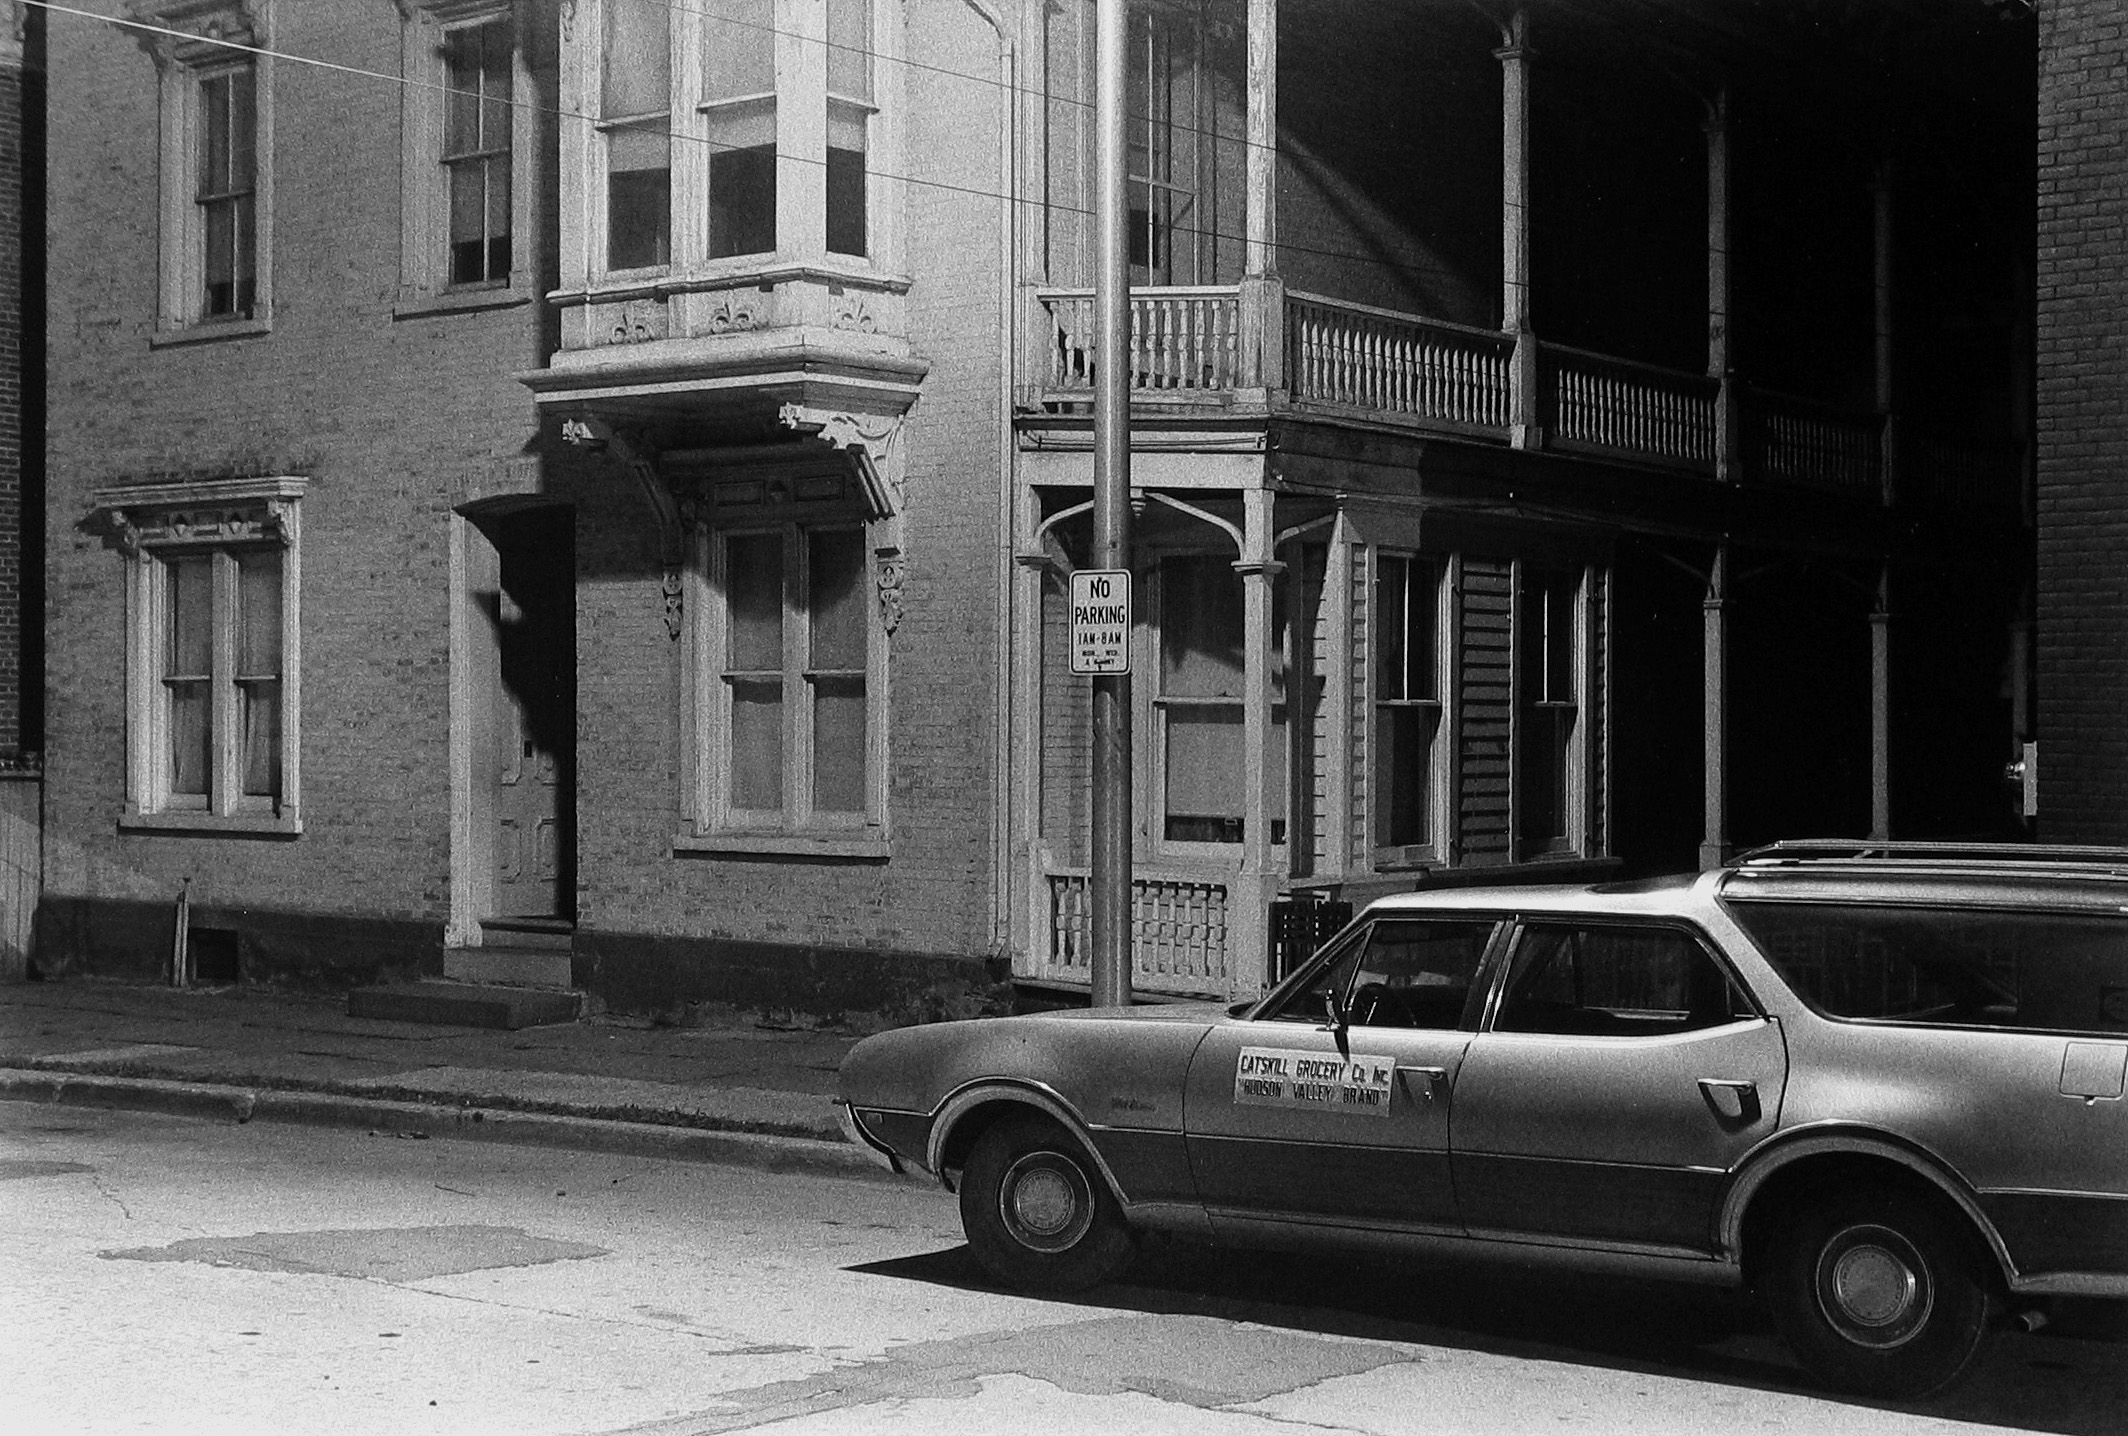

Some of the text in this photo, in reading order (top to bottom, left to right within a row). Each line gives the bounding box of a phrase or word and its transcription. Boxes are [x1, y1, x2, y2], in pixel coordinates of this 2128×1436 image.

[1091, 580, 1110, 598] NO
[1075, 605, 1125, 625] PARKING
[1241, 1056, 1288, 1076] CATSKILL
[1297, 1060, 1345, 1081] GROCERY
[1293, 1083, 1332, 1102] VALLEY
